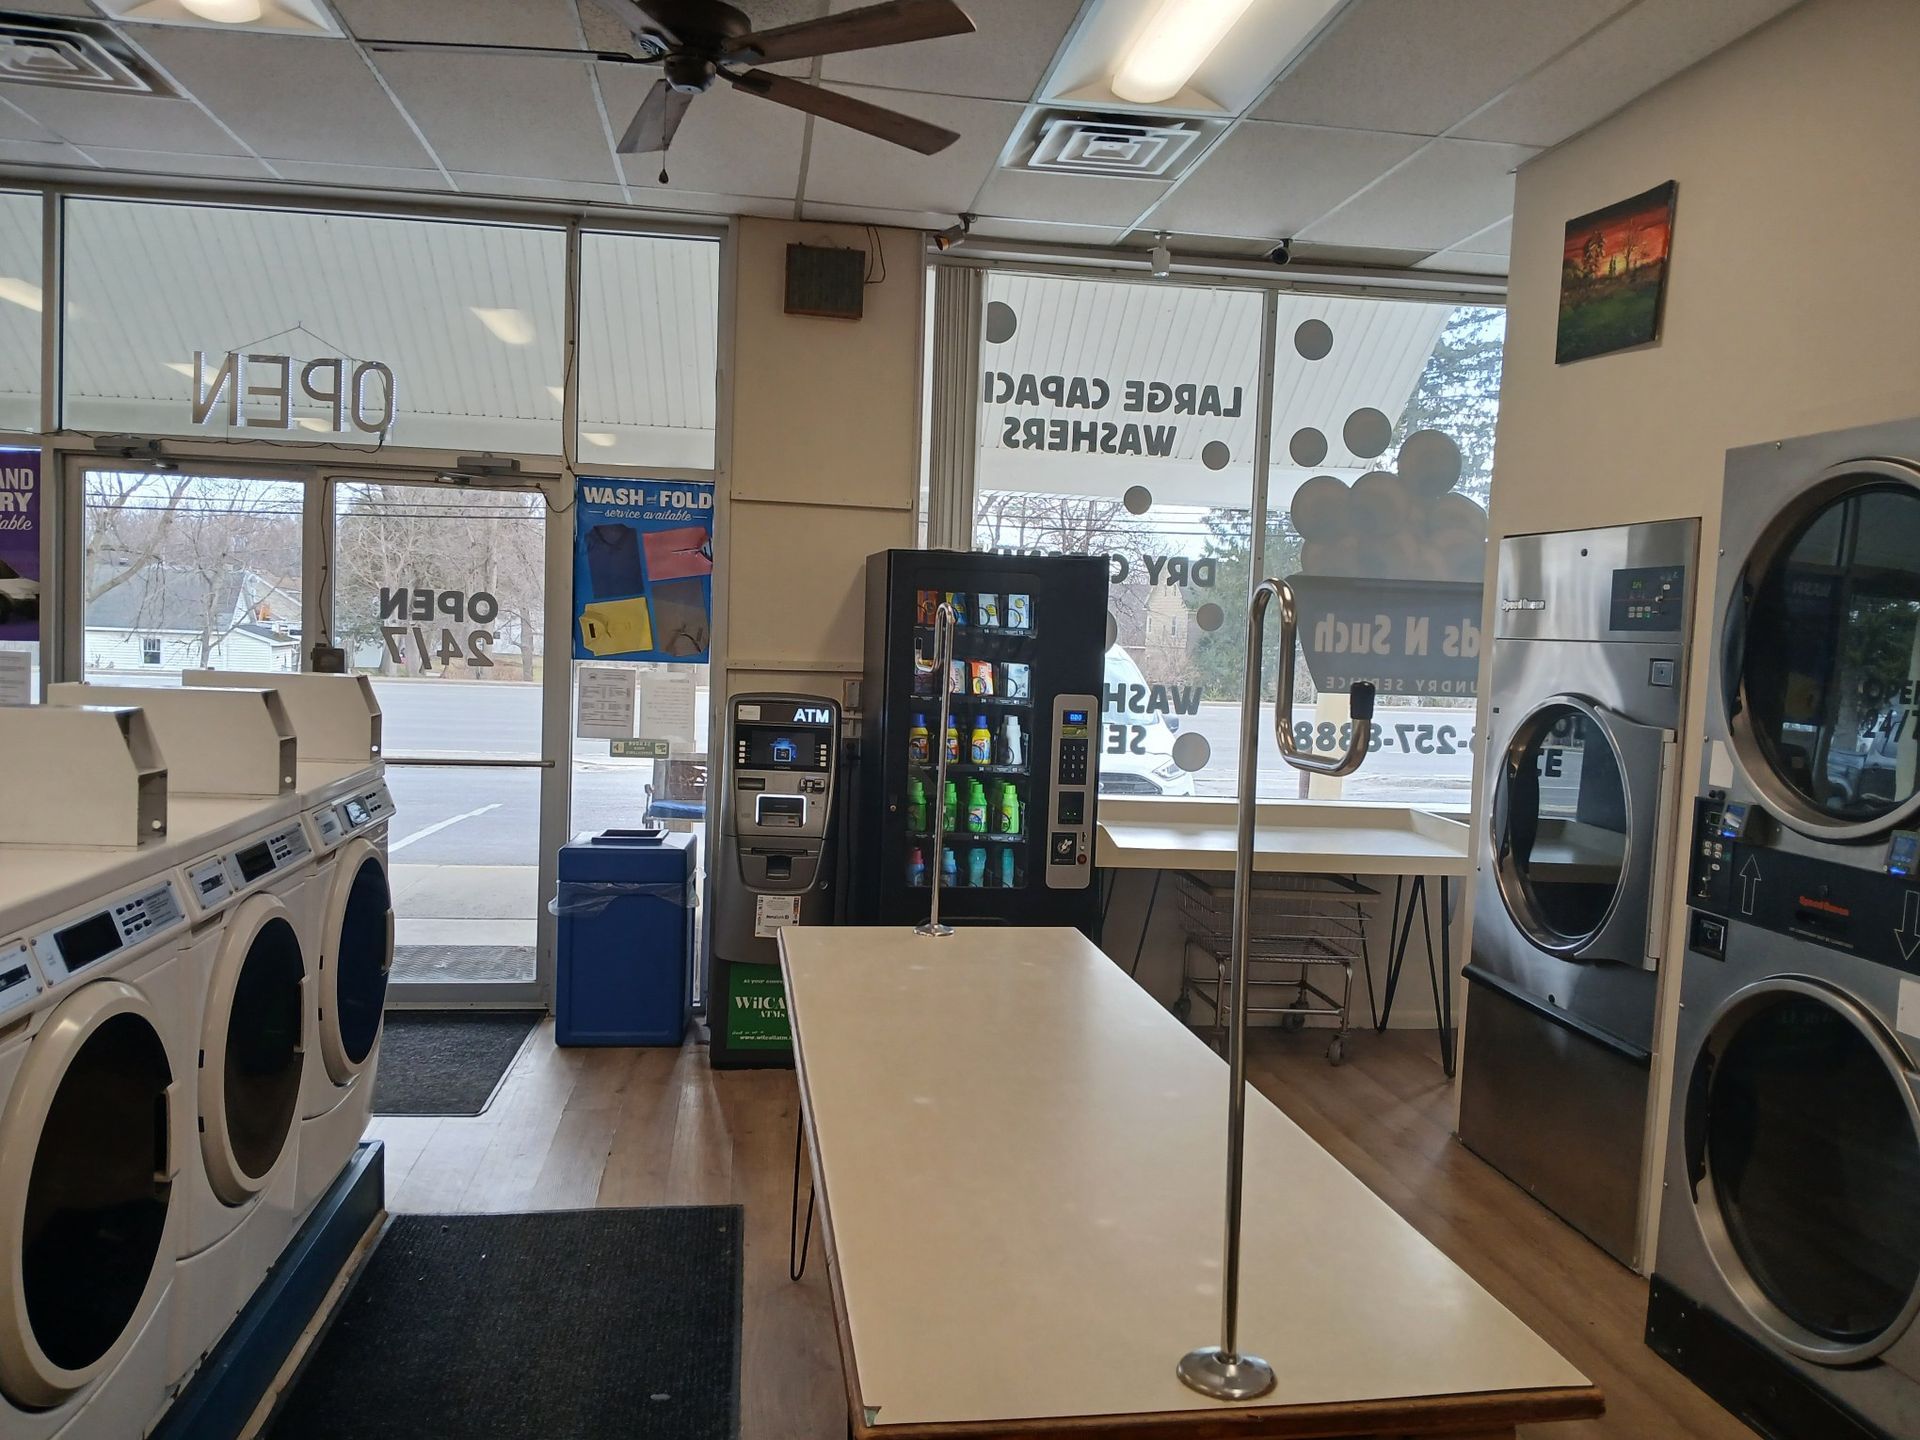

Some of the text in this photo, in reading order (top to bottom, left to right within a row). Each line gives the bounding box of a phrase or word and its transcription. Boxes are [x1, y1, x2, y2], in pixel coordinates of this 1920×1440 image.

[583, 486, 644, 506] WASH
[660, 490, 713, 509] FOLD
[604, 509, 692, 521] service available
[793, 708, 830, 723] ATM
